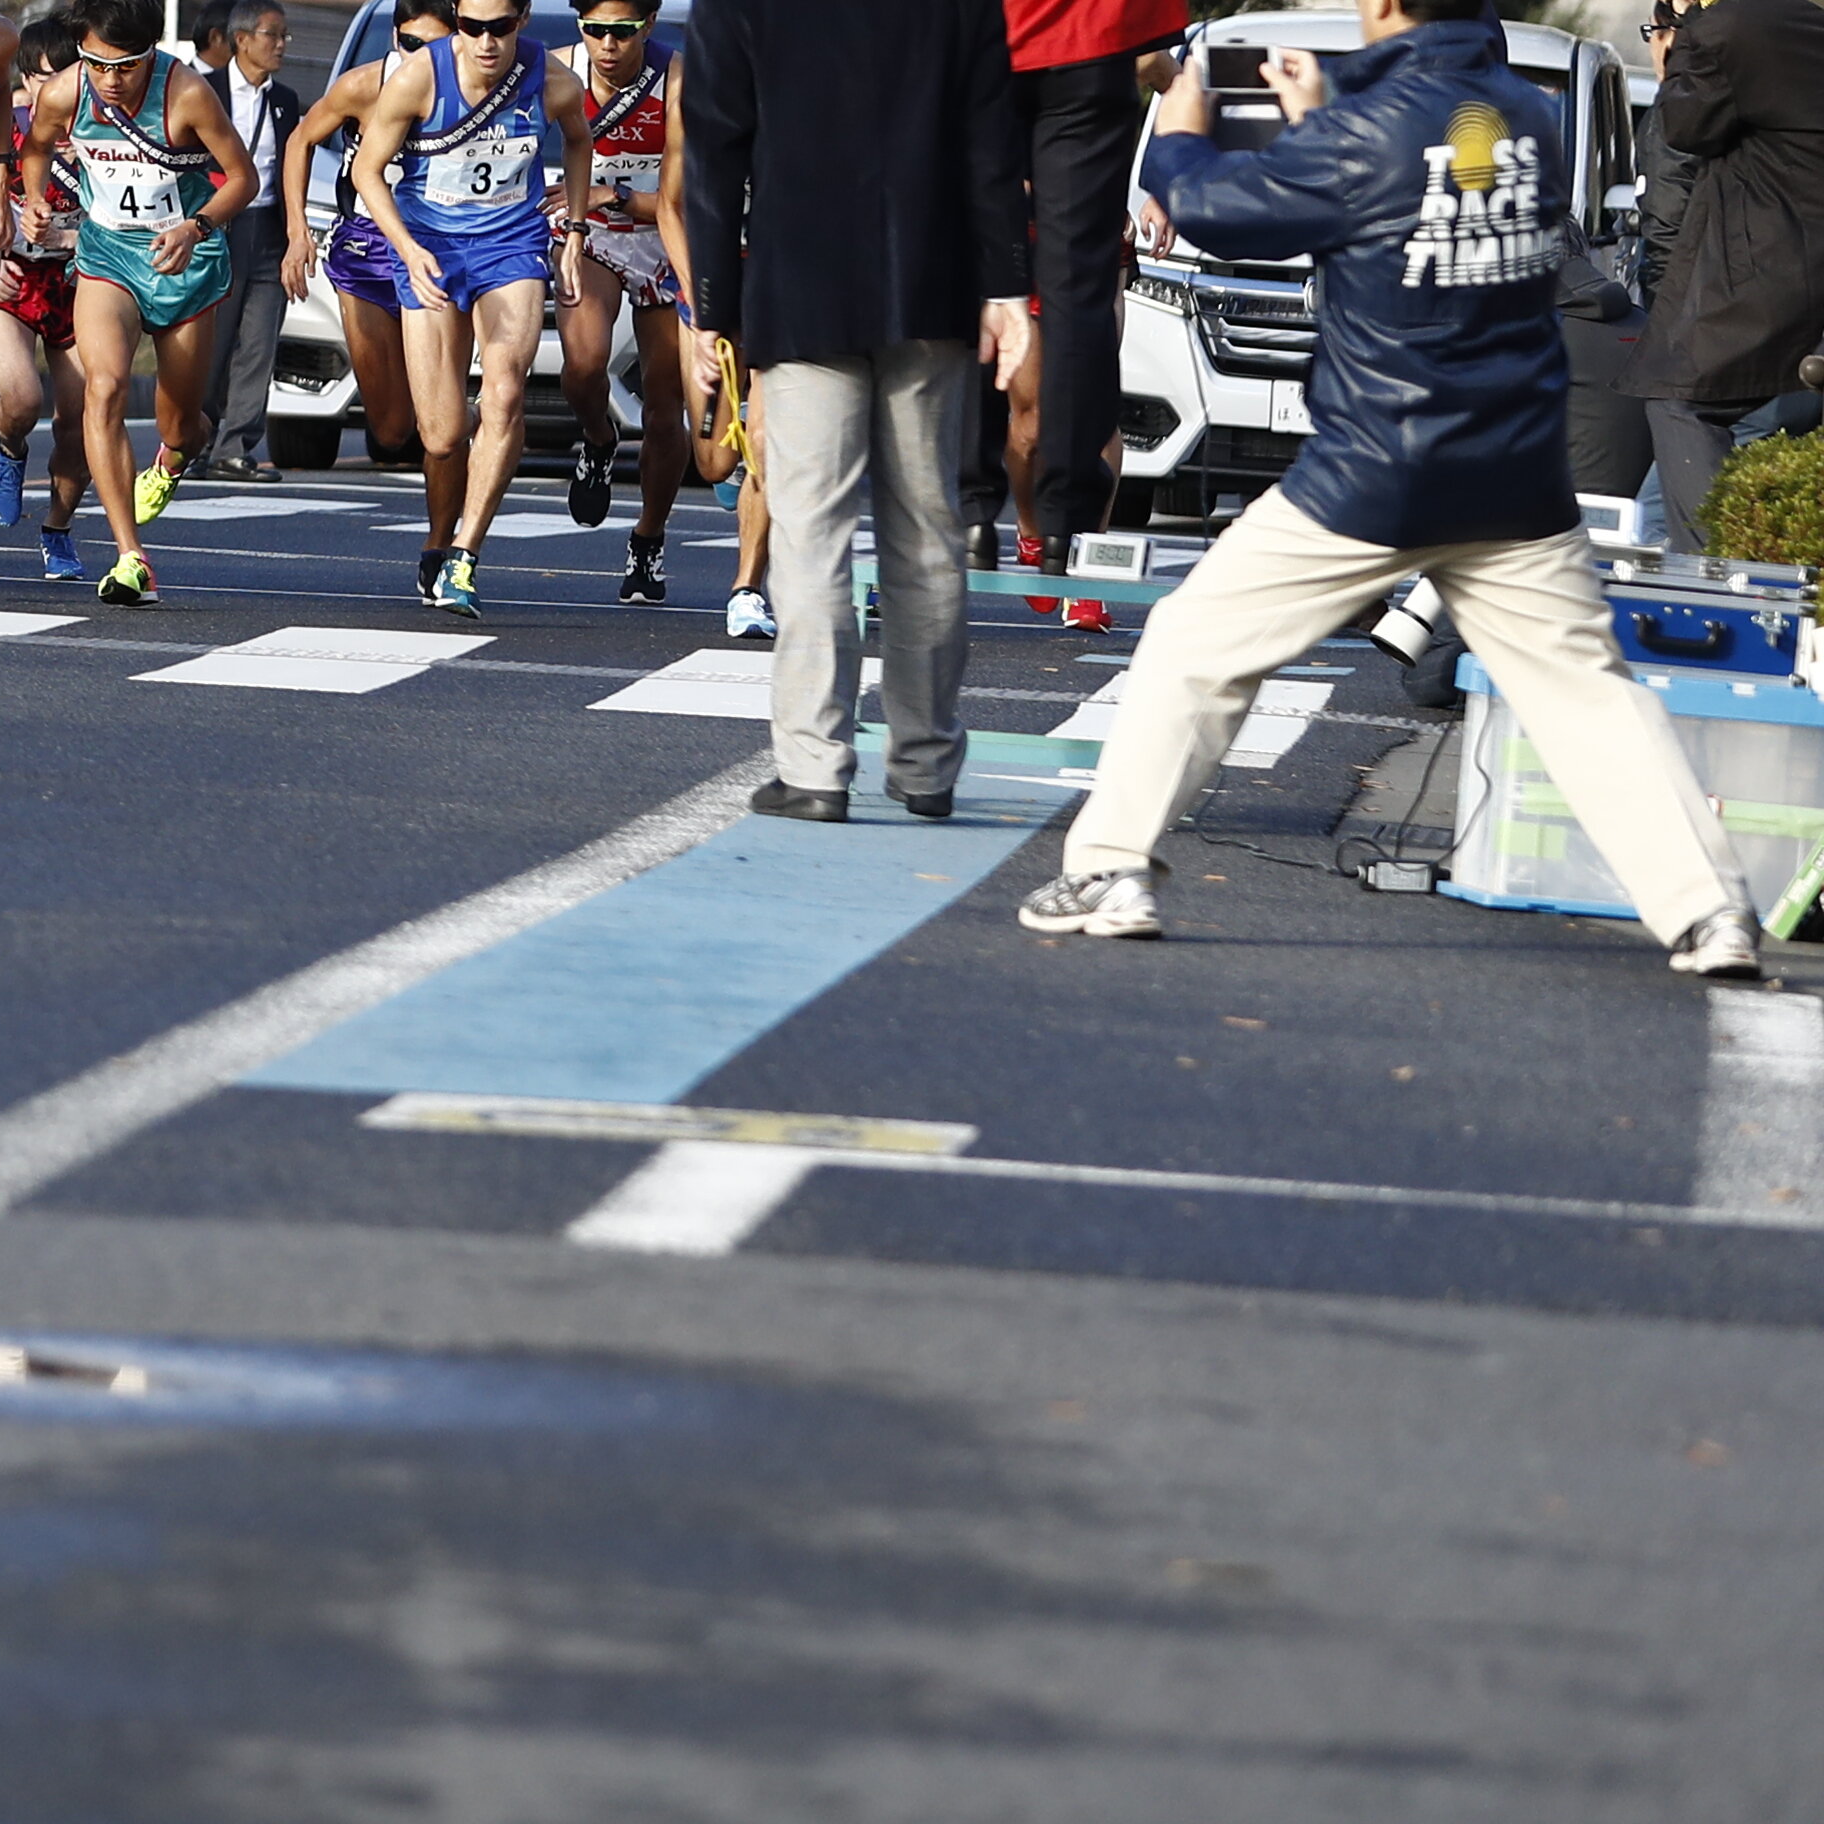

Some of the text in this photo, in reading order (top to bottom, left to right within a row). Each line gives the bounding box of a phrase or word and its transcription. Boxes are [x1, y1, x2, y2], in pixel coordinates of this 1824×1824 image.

[471, 162, 524, 195] 3-1
[119, 185, 174, 218] 4-1
[1412, 182, 1540, 241] RACE
